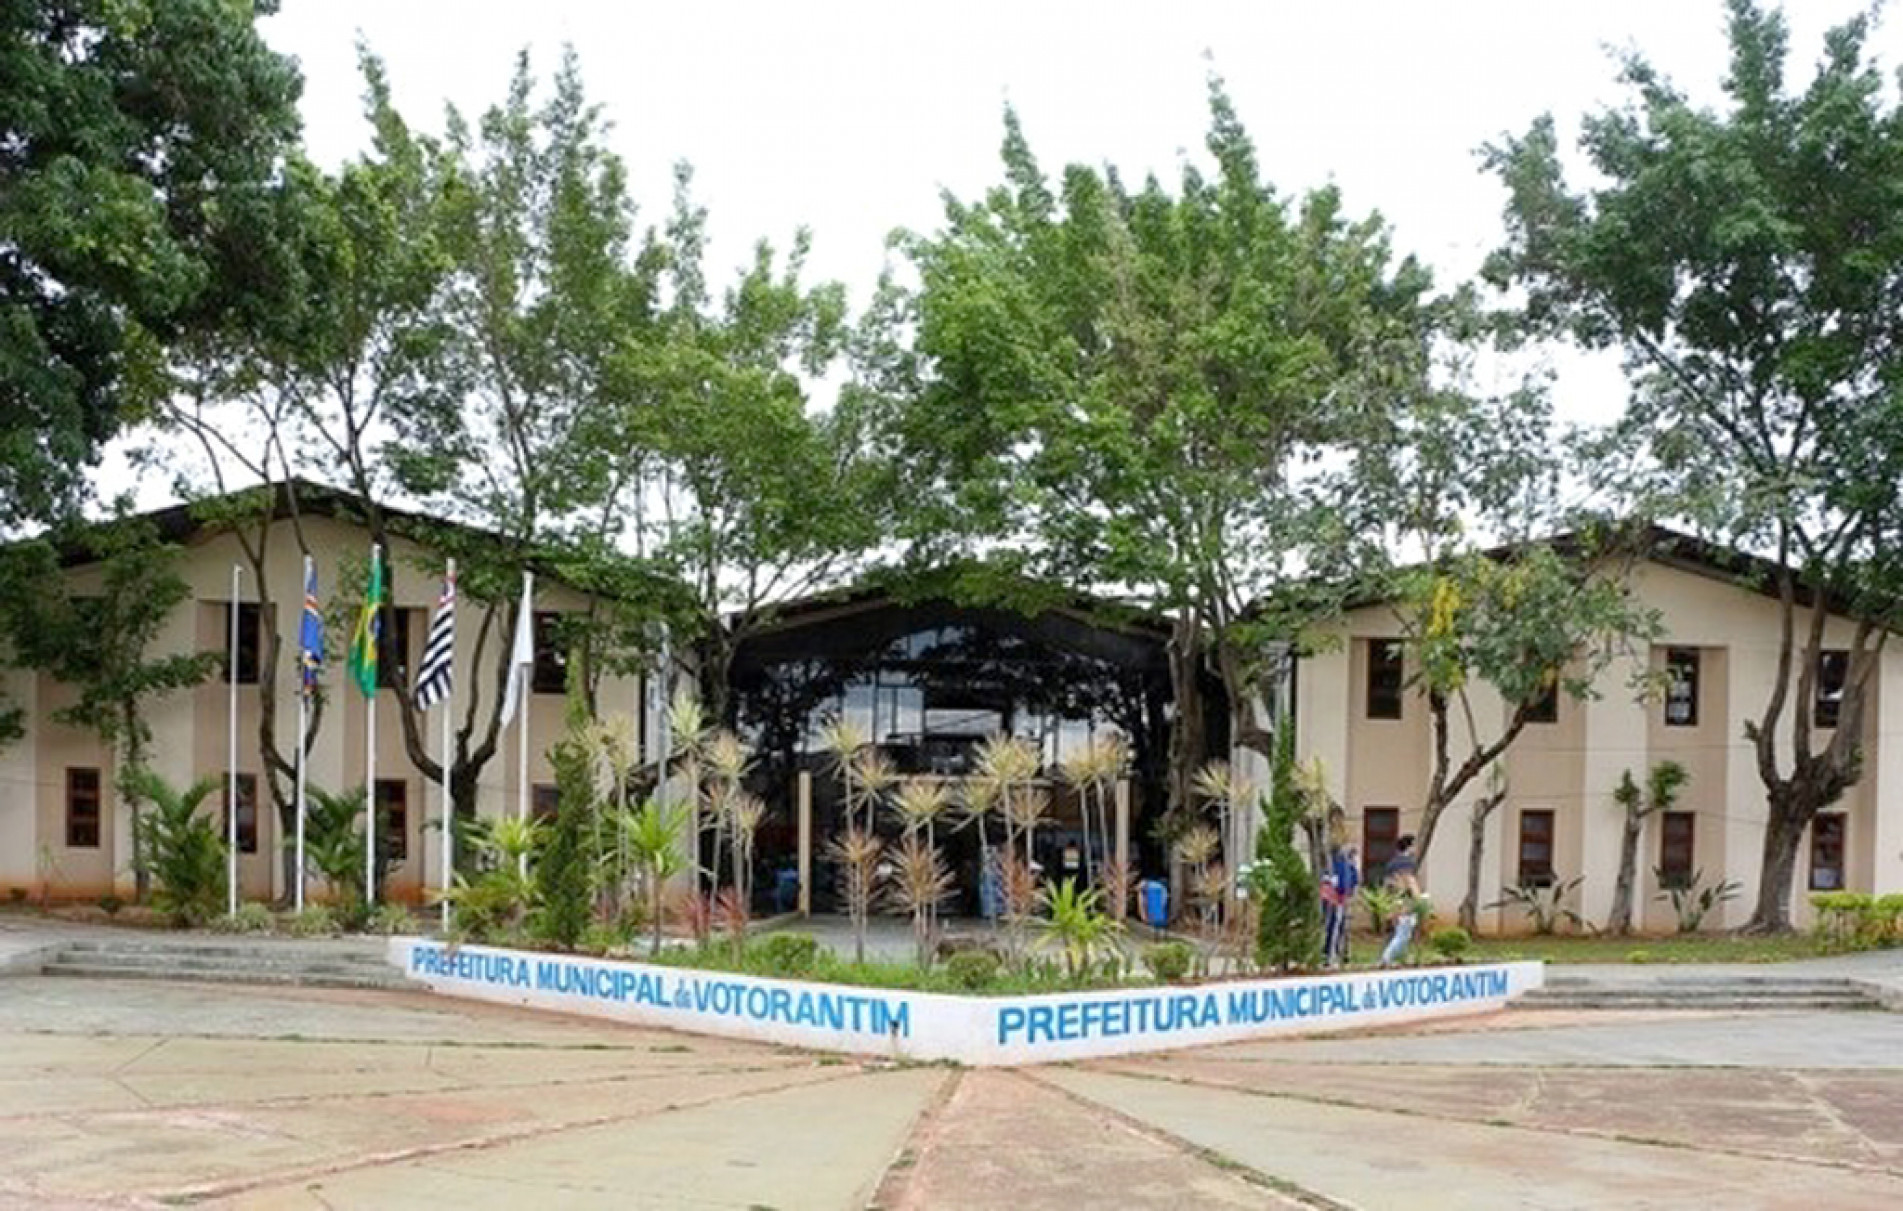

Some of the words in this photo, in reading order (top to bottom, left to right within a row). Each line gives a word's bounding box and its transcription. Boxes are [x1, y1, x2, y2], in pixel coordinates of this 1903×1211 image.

[536, 961, 671, 1007] MUNICIPAL
[693, 979, 910, 1037] VOTORANTIM
[998, 993, 1220, 1045] PREFEITURA
[1227, 980, 1361, 1024] MUNICIPAL
[1378, 970, 1508, 1009] VOTORANTIM
